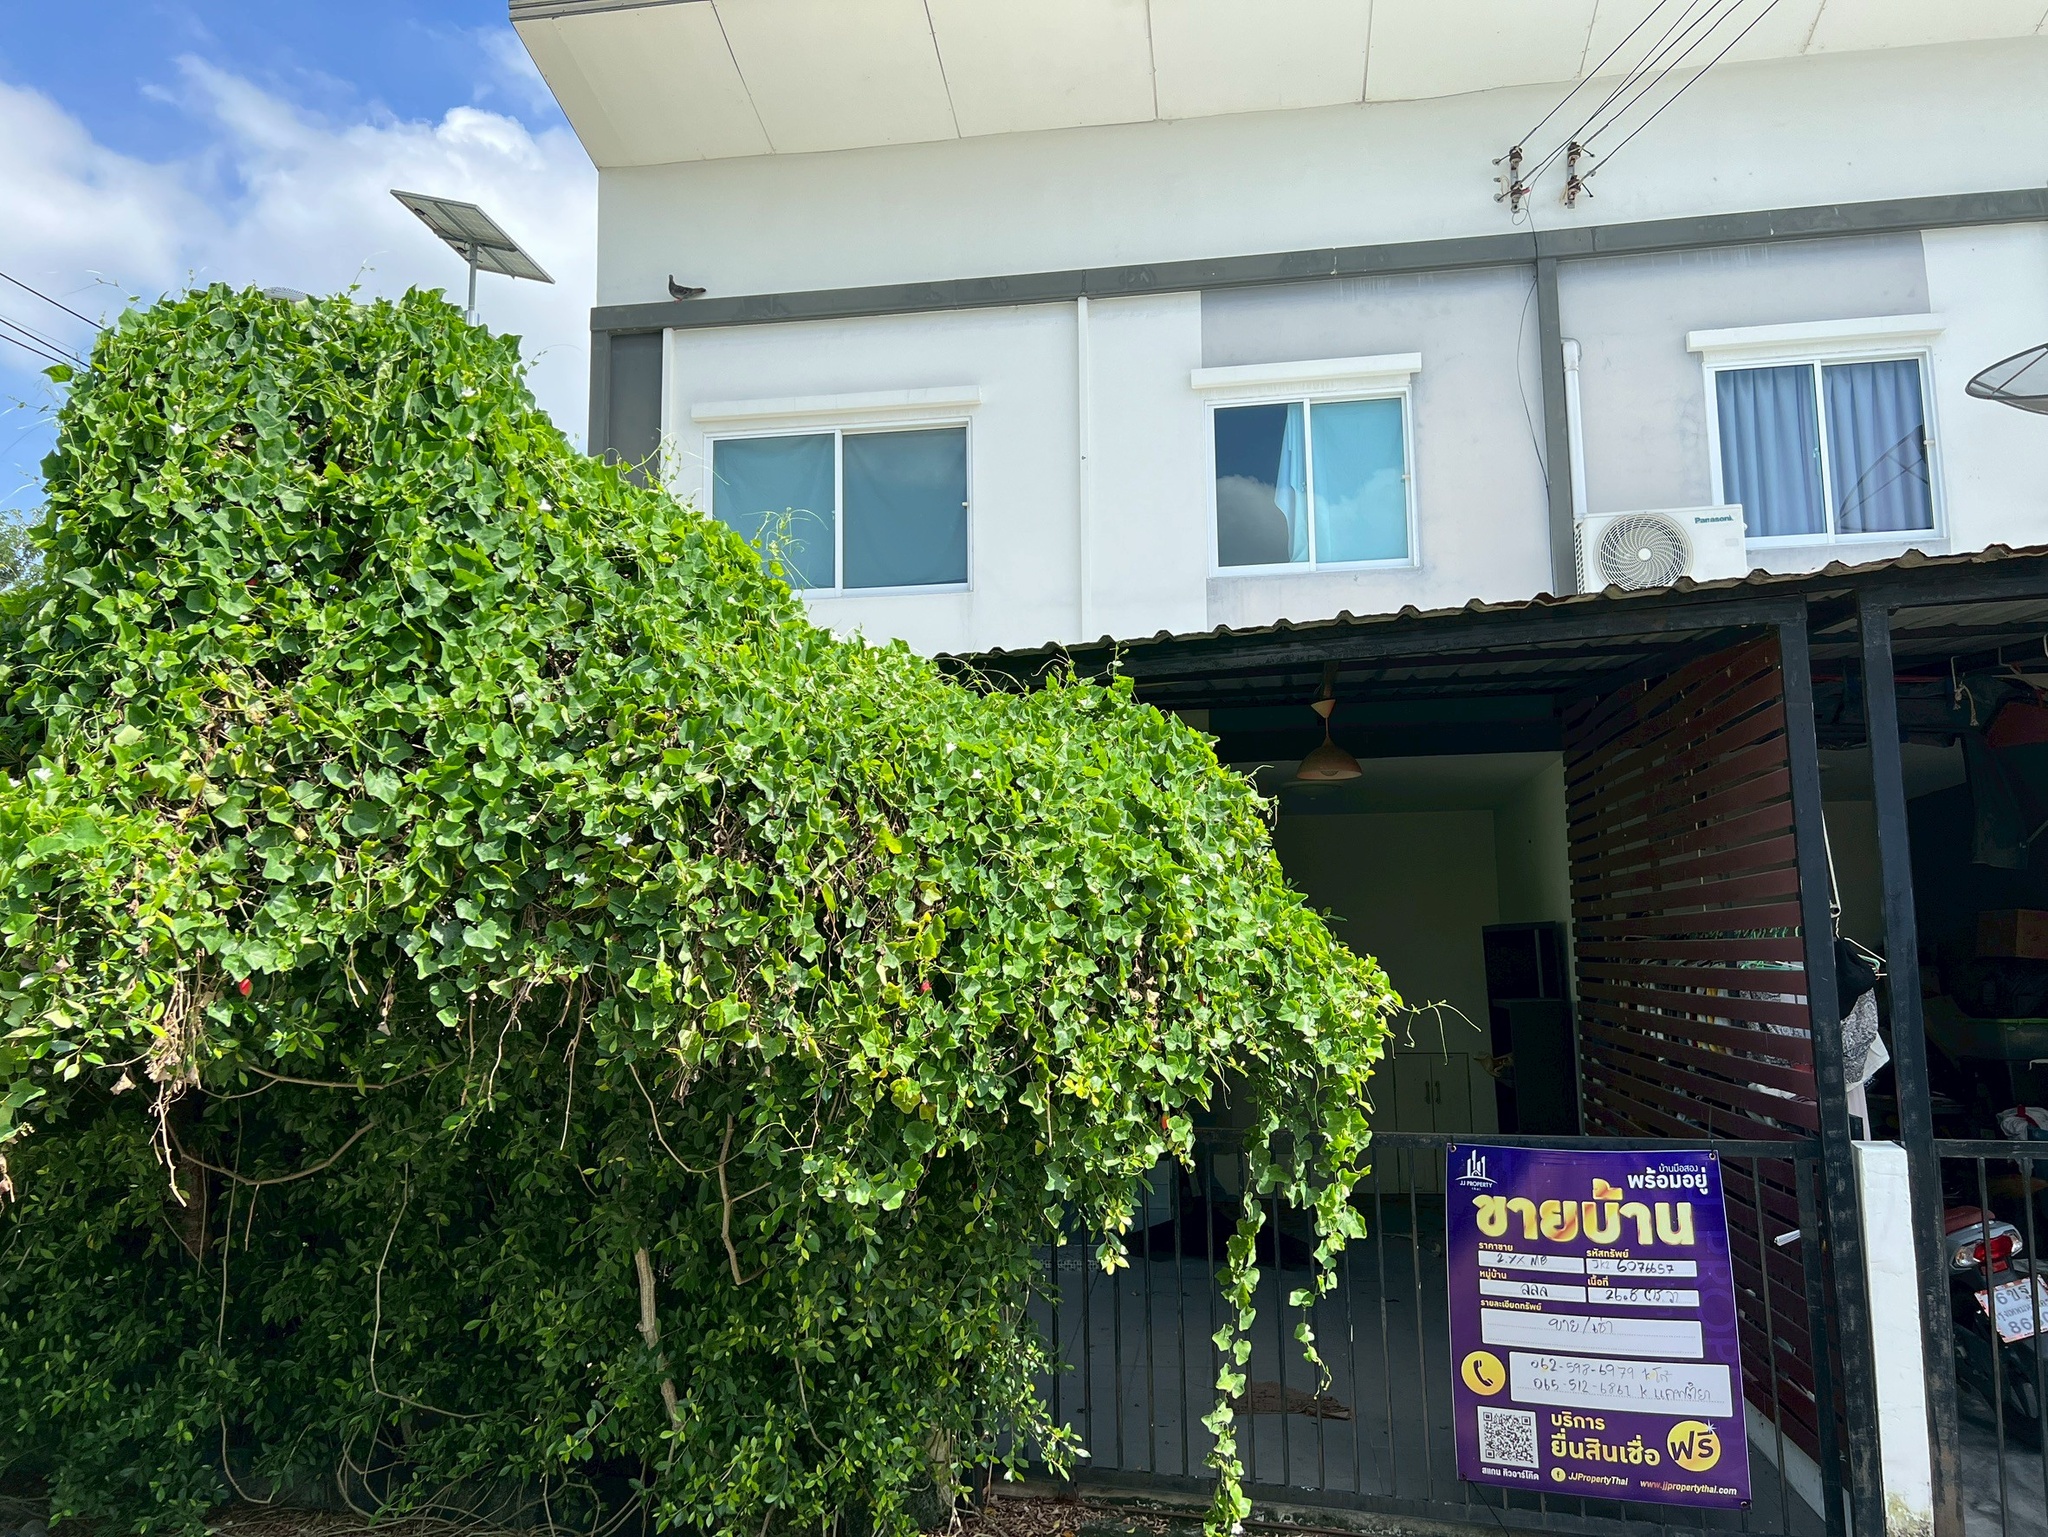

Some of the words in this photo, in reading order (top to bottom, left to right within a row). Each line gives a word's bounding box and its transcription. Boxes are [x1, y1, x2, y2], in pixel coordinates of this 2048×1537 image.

[1695, 514, 1734, 524] Panasoni
[1658, 1163, 1699, 1173] บ้านมือสอง
[1627, 1166, 1708, 1195] พร้อมอยู่
[1472, 1178, 1695, 1246] ขายบ้าน
[1478, 1242, 1514, 1252] ราคาขาย
[1586, 1248, 1630, 1259] รหัสทรัพย์
[1479, 1268, 1507, 1280] หมู่บ้าน
[1587, 1274, 1609, 1287] เนื้อที่
[1480, 1299, 1542, 1311] รายละเอียดทรัพย์
[1550, 1410, 1606, 1431] บริการ
[1550, 1427, 1661, 1467] ยื่นสินเชื่อ
[1568, 1472, 1629, 1487] JJPropertyThai
[1640, 1479, 1738, 1496] www.jjpropertythai.com
